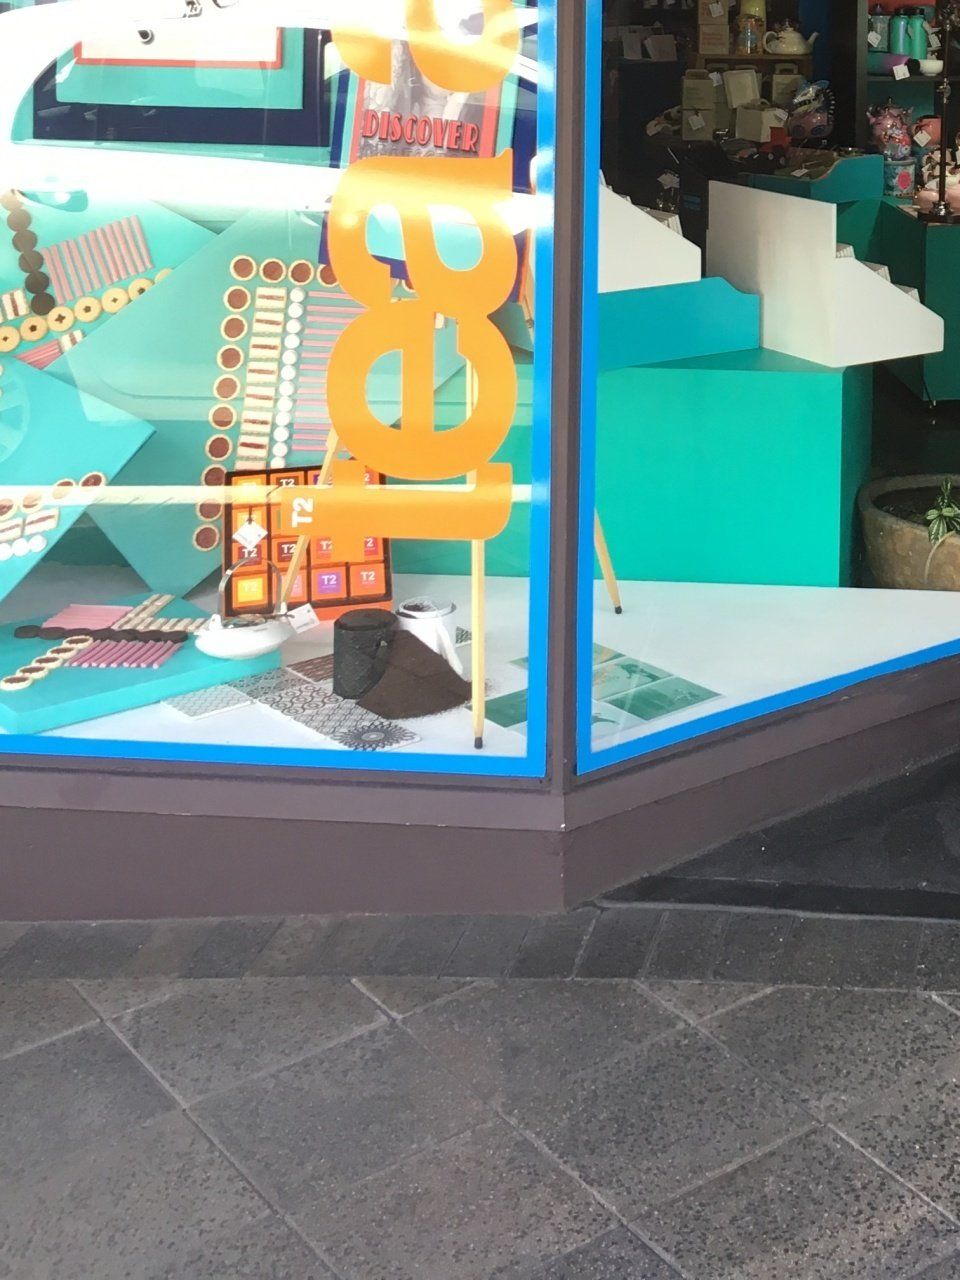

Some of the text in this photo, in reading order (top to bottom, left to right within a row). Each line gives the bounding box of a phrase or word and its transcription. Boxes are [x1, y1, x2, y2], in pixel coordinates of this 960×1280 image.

[361, 108, 480, 153] DISCOVER
[280, 147, 519, 563] tea
[291, 496, 314, 529] T2
[241, 547, 258, 558] T2
[320, 574, 338, 585] T2
[360, 570, 376, 582] T2
